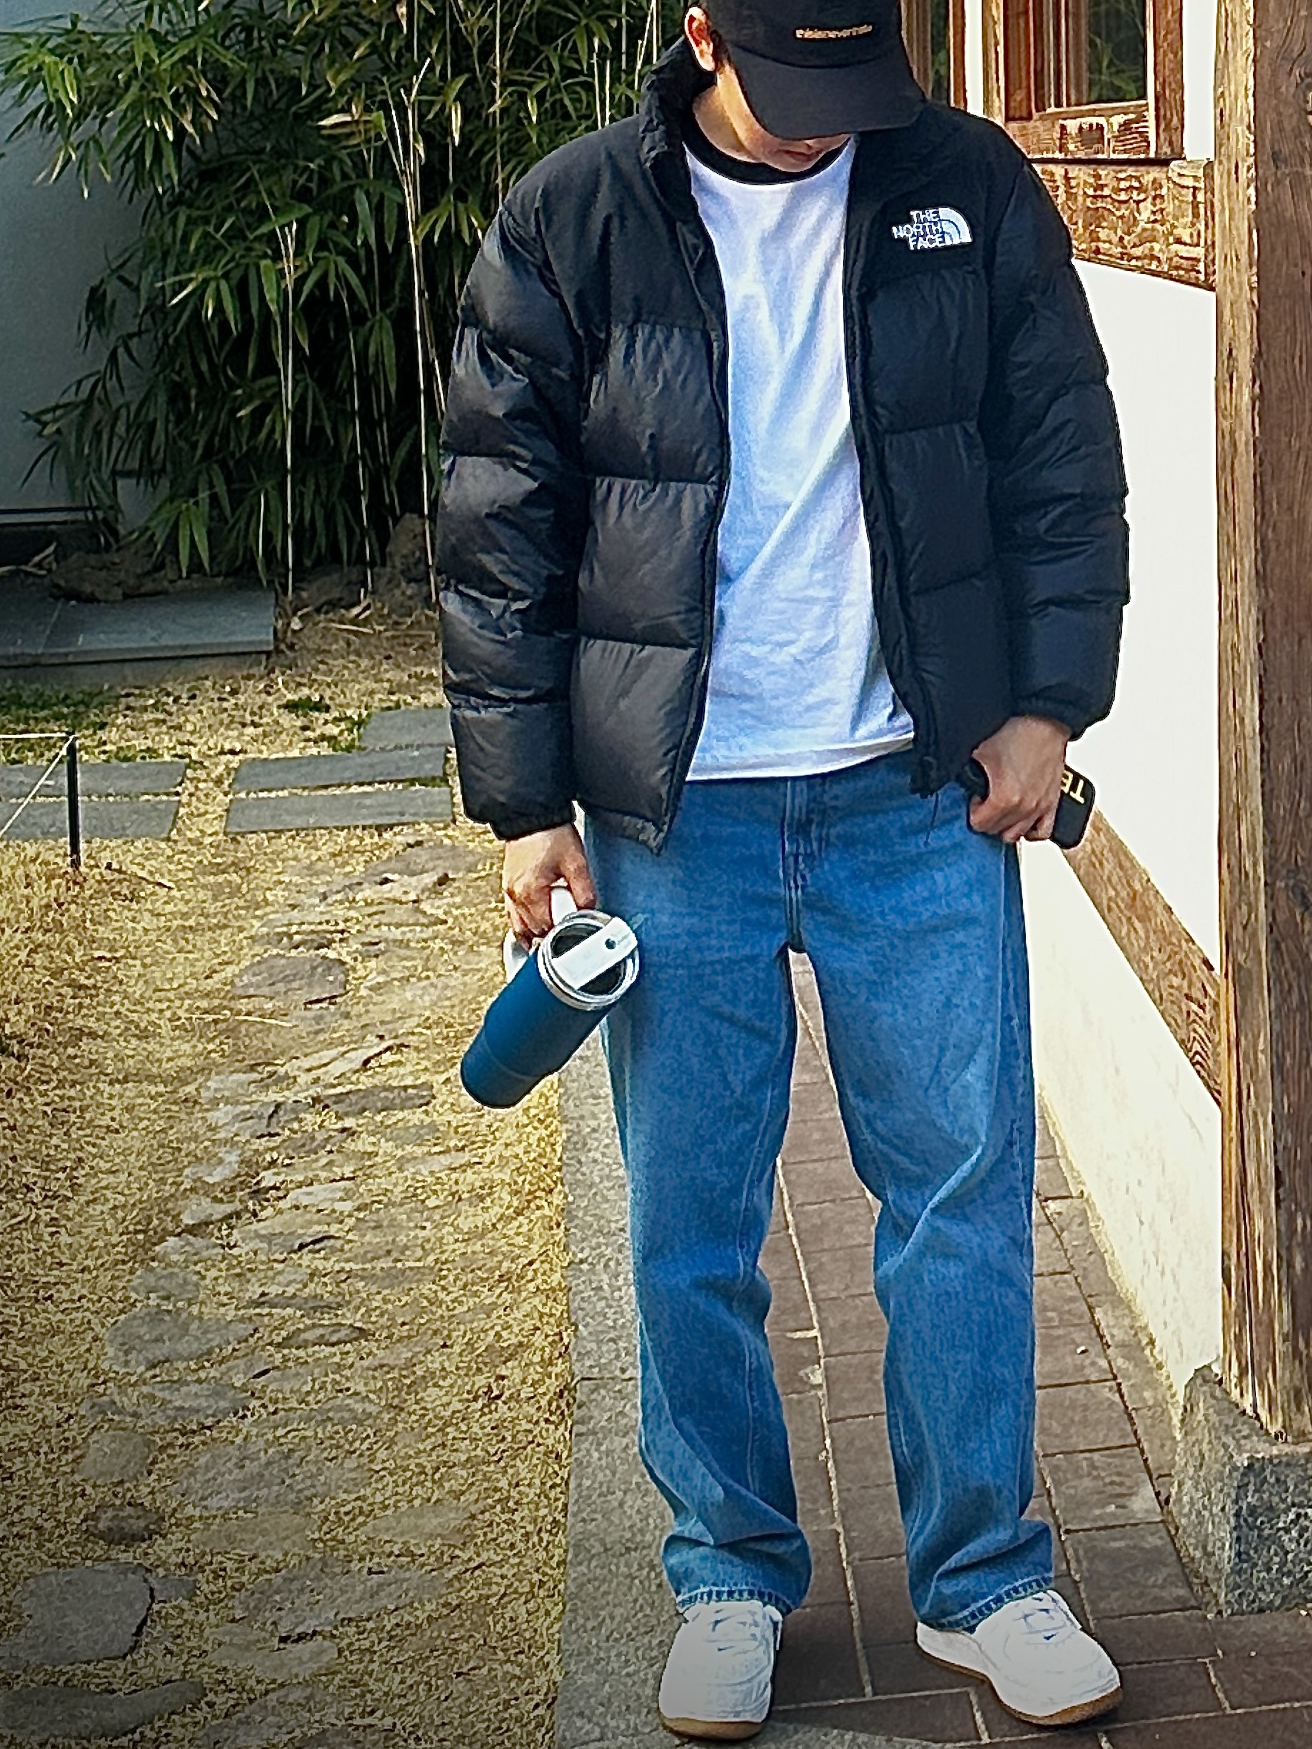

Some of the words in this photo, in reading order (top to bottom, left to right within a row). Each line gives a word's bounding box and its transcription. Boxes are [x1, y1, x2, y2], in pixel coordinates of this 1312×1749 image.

[910, 209, 940, 223] THE
[892, 220, 943, 238] NORTH
[909, 234, 945, 250] FACE
